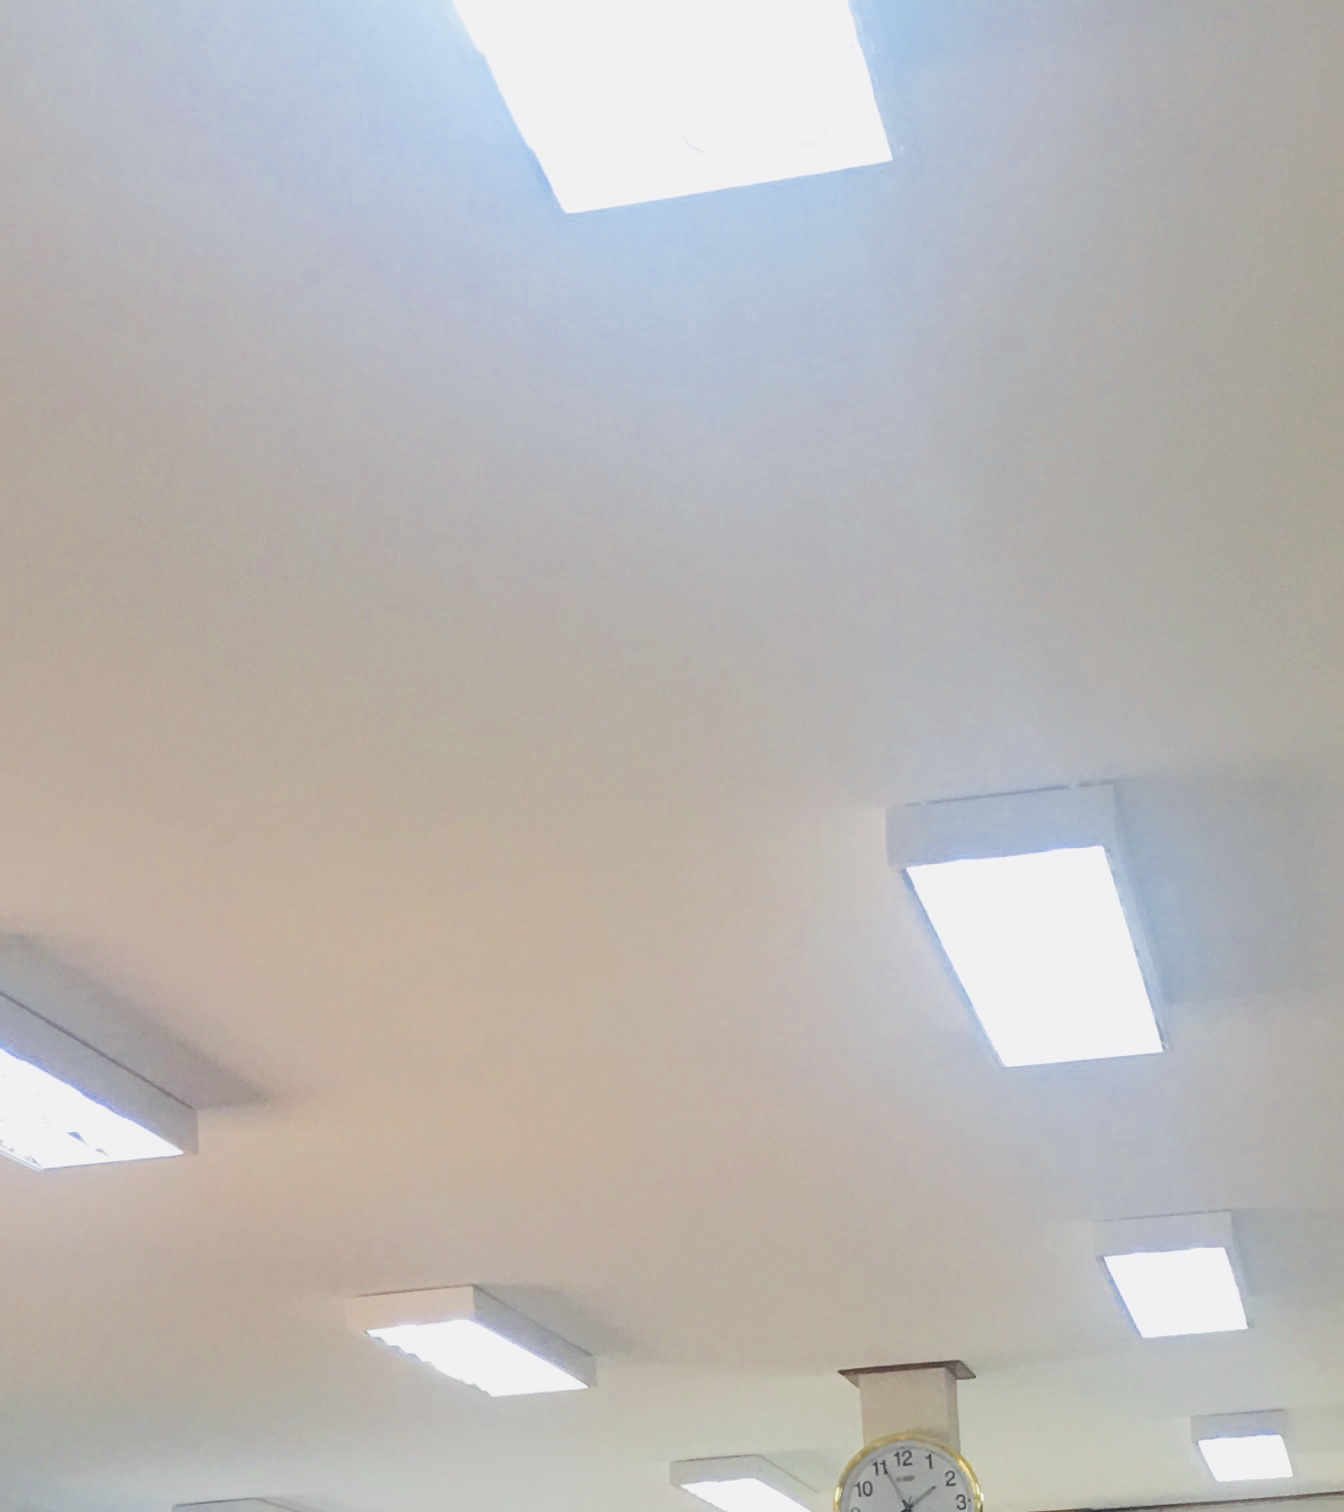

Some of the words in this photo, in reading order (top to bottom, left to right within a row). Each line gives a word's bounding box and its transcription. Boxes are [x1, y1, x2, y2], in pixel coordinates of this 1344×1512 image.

[894, 1450, 913, 1467] 12
[925, 1453, 933, 1470] 1
[872, 1459, 889, 1476] 11
[945, 1470, 956, 1487] 2
[855, 1480, 873, 1497] 10
[956, 1494, 967, 1511] 3
